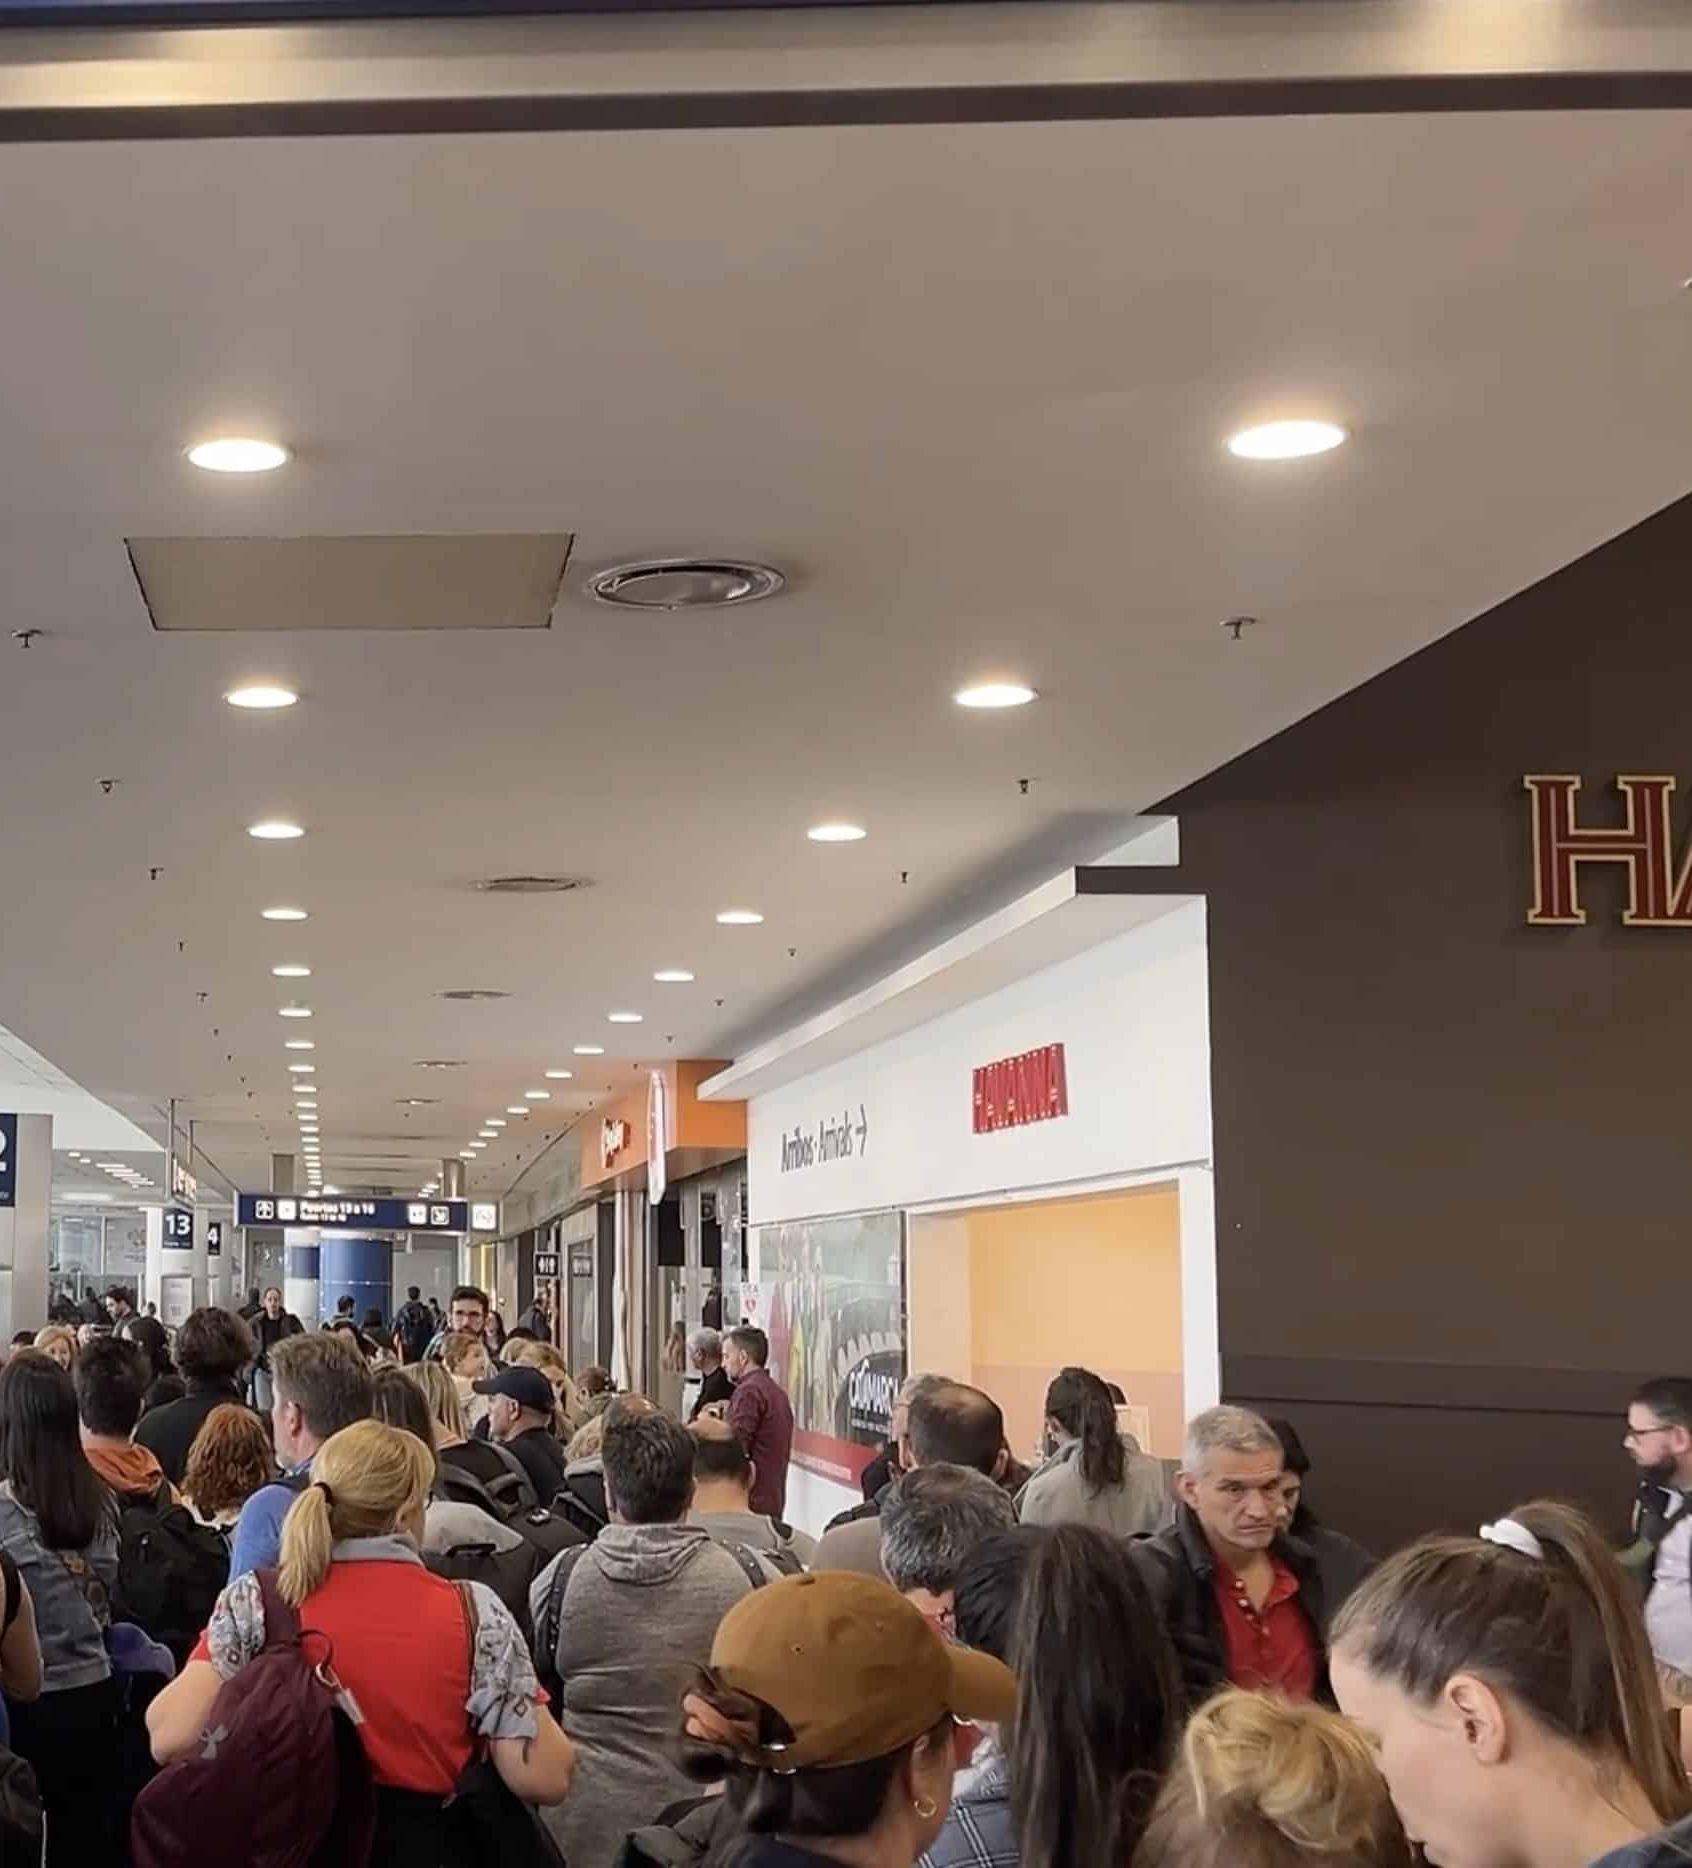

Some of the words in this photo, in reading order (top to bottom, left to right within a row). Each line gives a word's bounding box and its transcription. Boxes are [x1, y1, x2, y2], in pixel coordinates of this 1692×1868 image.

[1524, 775, 1692, 926] H
[780, 1126, 814, 1174] Arribos
[819, 1109, 853, 1163] Arrivals
[165, 1214, 191, 1236] 13
